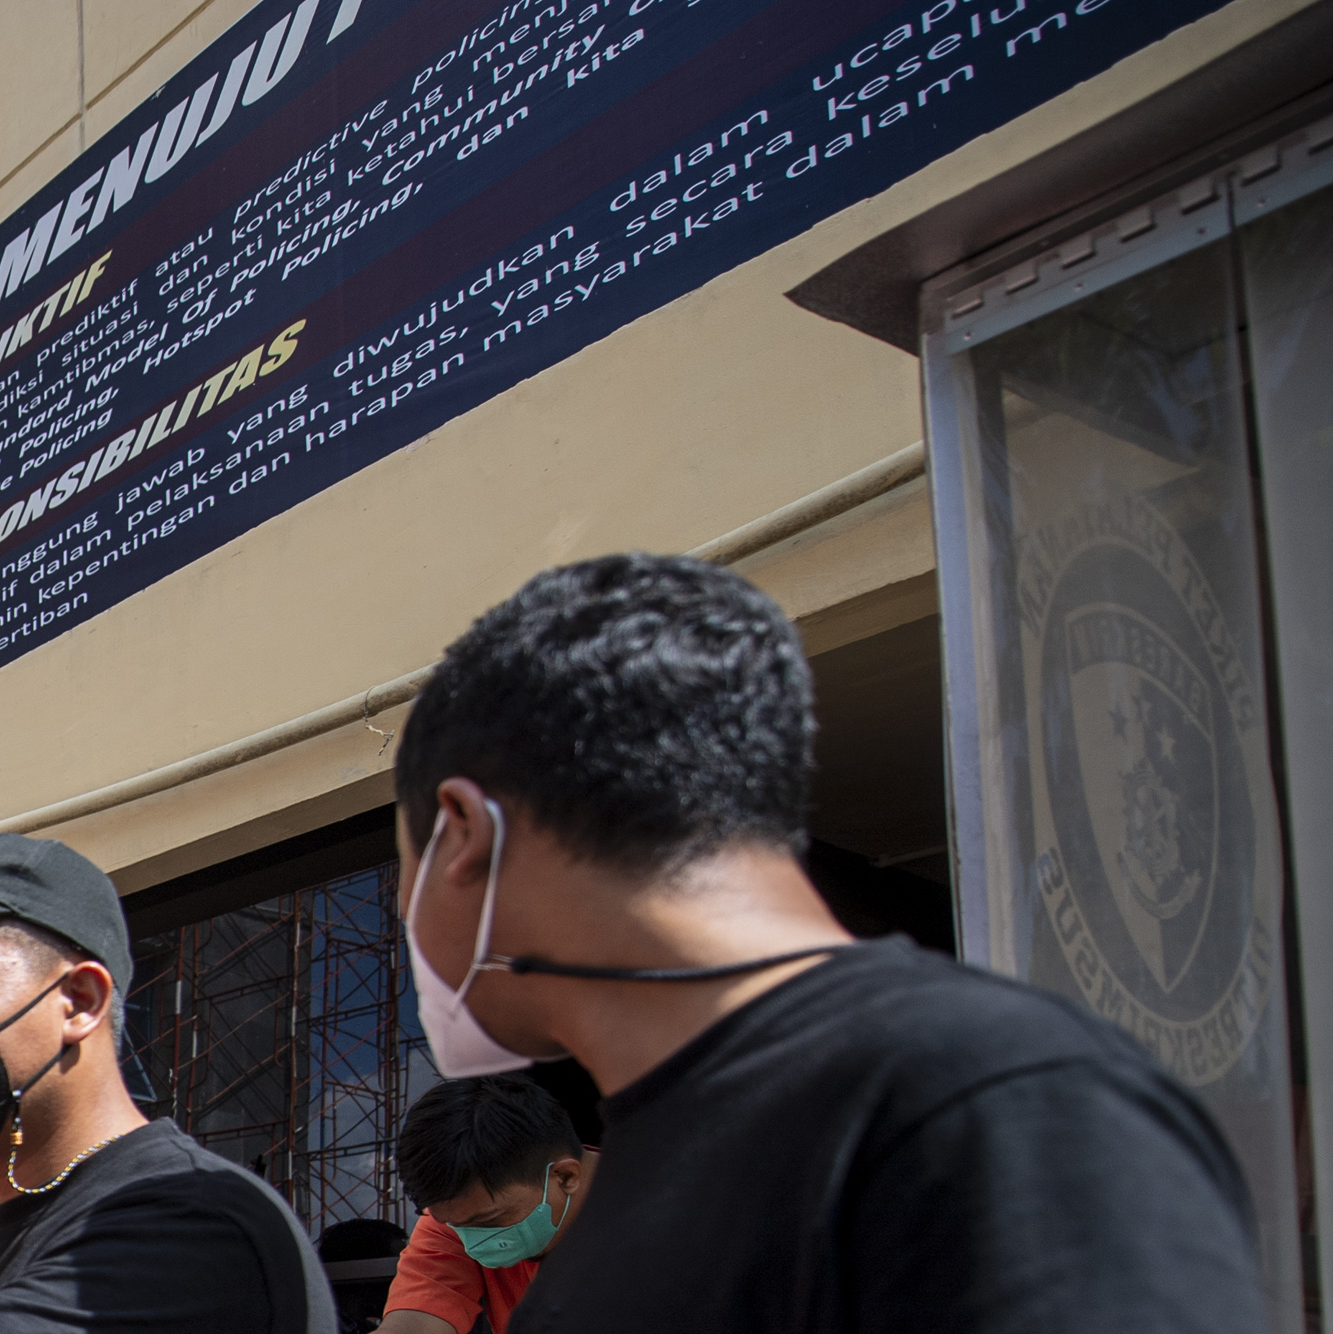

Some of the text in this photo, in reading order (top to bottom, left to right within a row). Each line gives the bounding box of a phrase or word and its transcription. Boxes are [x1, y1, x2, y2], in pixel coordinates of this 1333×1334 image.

[17, 319, 155, 419] kamtibmas,
[166, 235, 264, 314] seperti
[276, 191, 333, 236] kita
[346, 84, 474, 187] ketahui
[492, 0, 610, 85] bersa
[29, 529, 112, 585] dalam
[127, 400, 330, 532] pelaksanaan
[347, 324, 470, 398] tugas,
[491, 240, 600, 316] yang
[625, 129, 794, 238] secara
[36, 278, 139, 367] prediktif
[155, 227, 213, 278] atau
[234, 100, 388, 224] predictive
[411, 0, 539, 94] policin
[38, 492, 216, 604] kepentingan
[228, 449, 292, 496] dan
[305, 352, 464, 452] harapan
[482, 180, 765, 352] masyarakat
[785, 61, 976, 180] dalam
[61, 302, 138, 367] situasi
[158, 254, 209, 296] dan
[231, 159, 336, 246] kondisi
[362, 83, 443, 152] yang
[84, 322, 168, 393] Model
[182, 288, 218, 325] Of
[381, 24, 605, 186] Community
[115, 444, 206, 514] jawab
[226, 384, 309, 443] yang
[332, 224, 576, 378] diwujudkan
[609, 107, 770, 212] dalam
[812, 0, 969, 91] ucap
[142, 287, 258, 375] Hotspot
[456, 104, 530, 161] dan
[565, 27, 646, 89] kita
[19, 407, 113, 479] Policing
